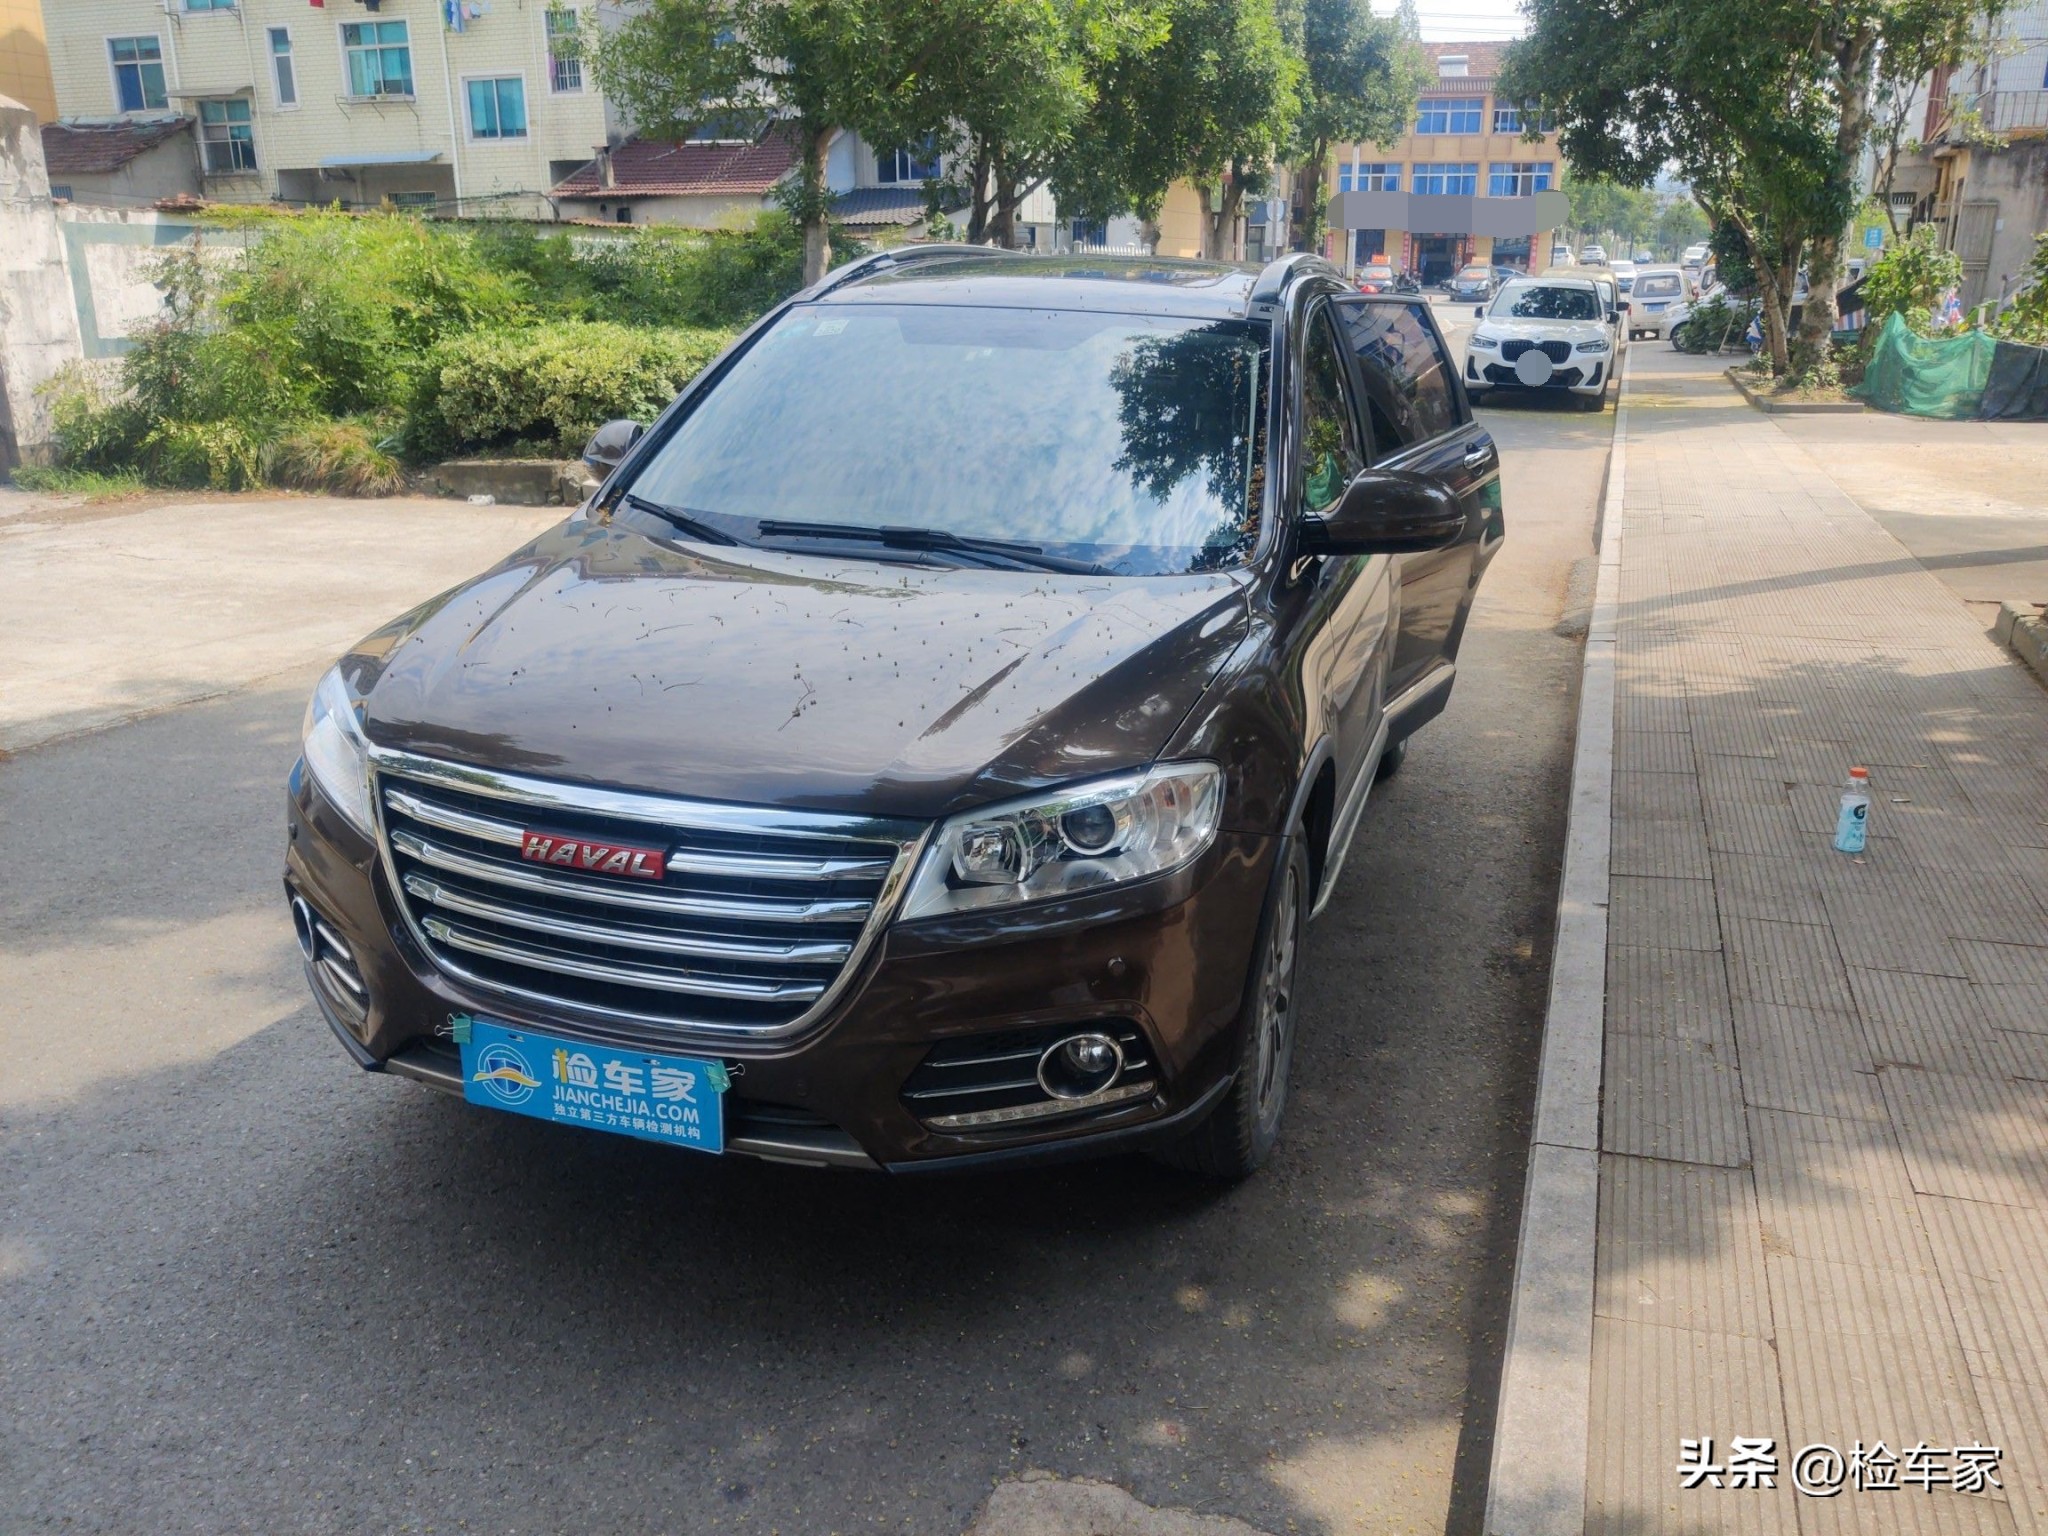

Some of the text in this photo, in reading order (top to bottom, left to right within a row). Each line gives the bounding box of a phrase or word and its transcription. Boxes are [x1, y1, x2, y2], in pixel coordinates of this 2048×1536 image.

[524, 836, 656, 877] HAVAL
[551, 1048, 697, 1104] 检车家
[552, 1086, 699, 1124] JIANCHEJIA.COM
[553, 1103, 701, 1140] 独立第三方车辆检测机构
